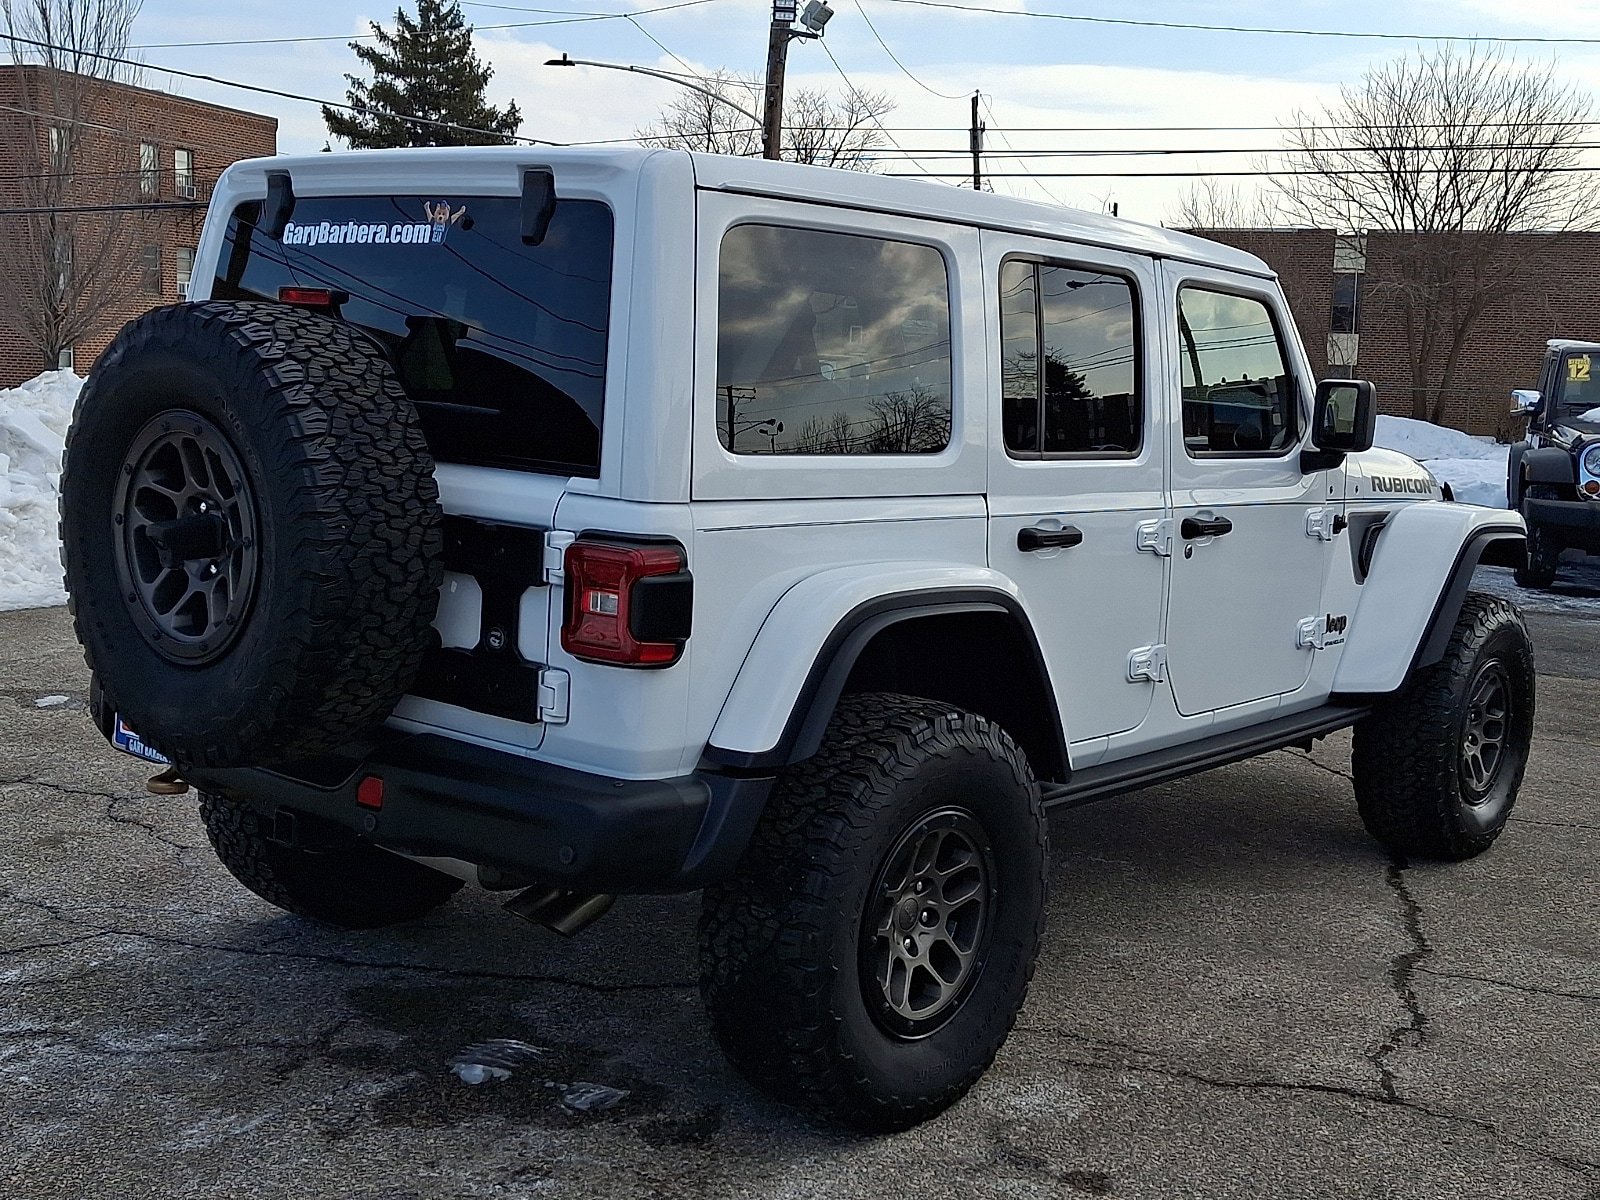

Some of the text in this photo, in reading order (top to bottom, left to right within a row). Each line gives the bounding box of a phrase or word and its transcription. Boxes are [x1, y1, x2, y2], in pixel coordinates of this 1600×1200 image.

[282, 222, 431, 246] GaryBarbera.com
[1568, 364, 1590, 378] 12
[1371, 475, 1432, 494] RUBICON
[1325, 613, 1347, 635] Jeep
[129, 739, 145, 755] GARY
